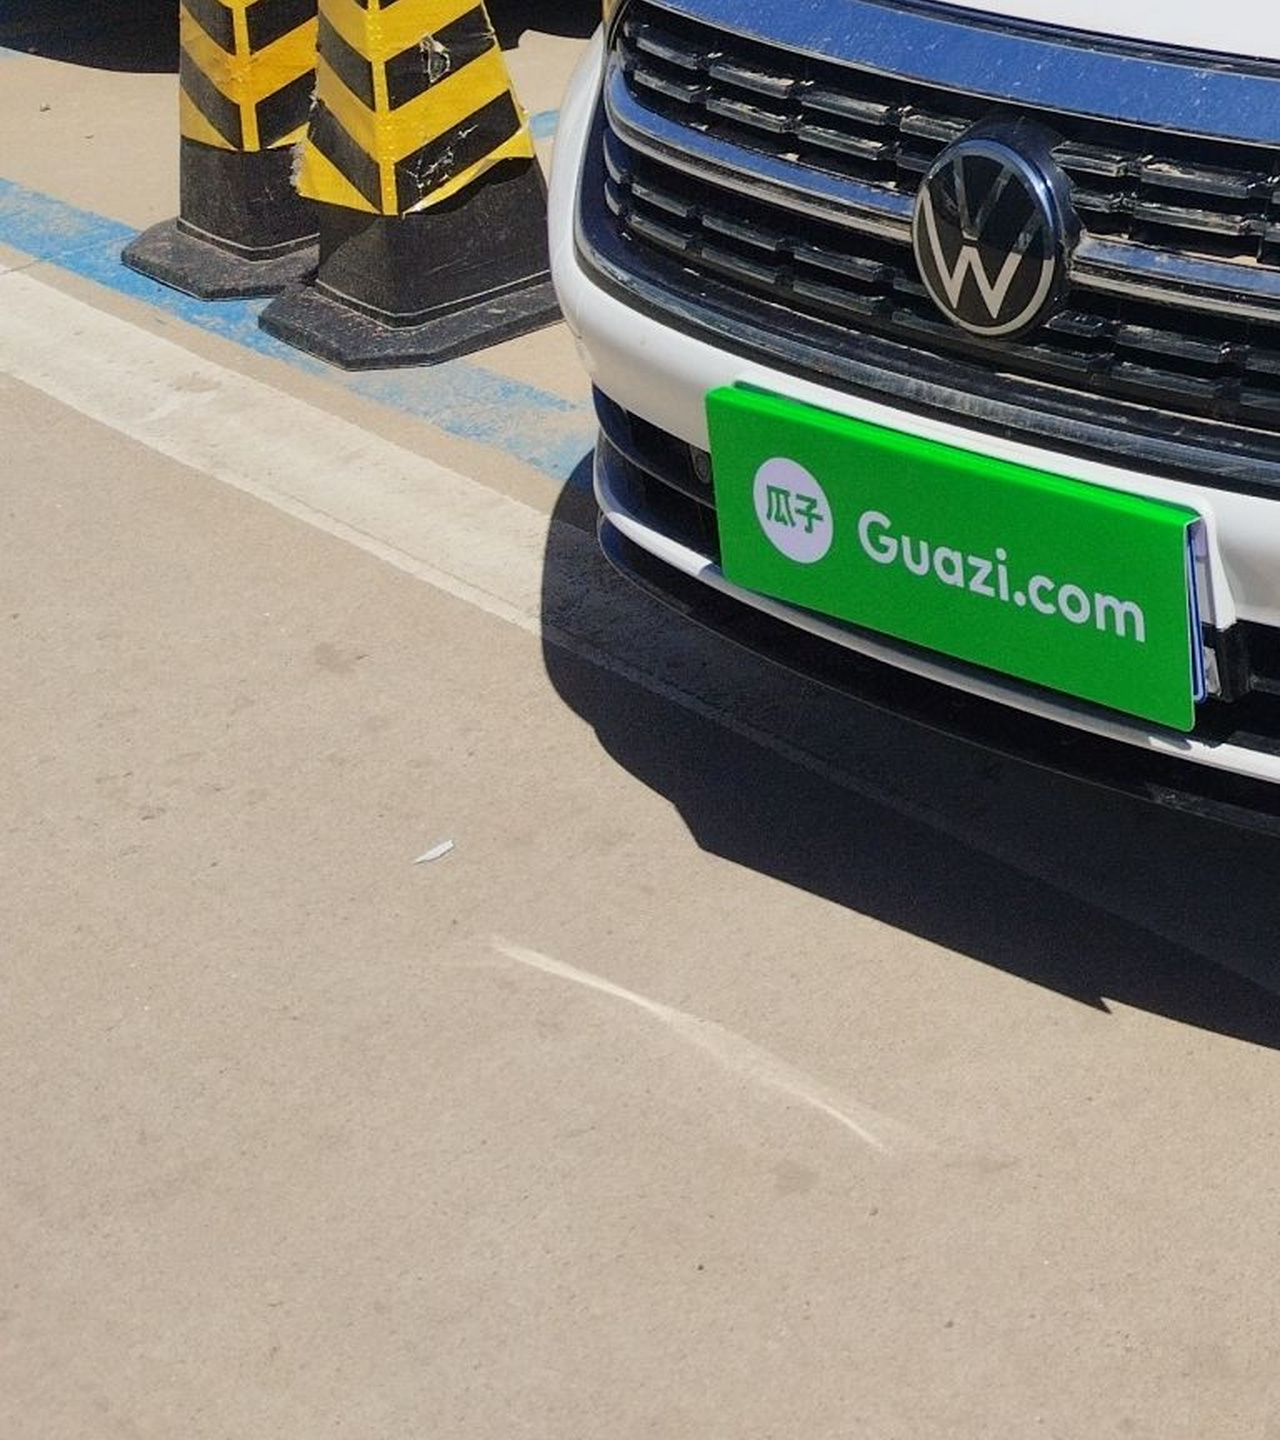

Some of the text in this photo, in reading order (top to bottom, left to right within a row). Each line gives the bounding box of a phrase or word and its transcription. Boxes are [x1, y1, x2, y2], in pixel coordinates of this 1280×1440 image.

[912, 138, 1055, 337] VW
[765, 484, 824, 534] 瓜子
[857, 510, 1146, 643] Guazi.com
